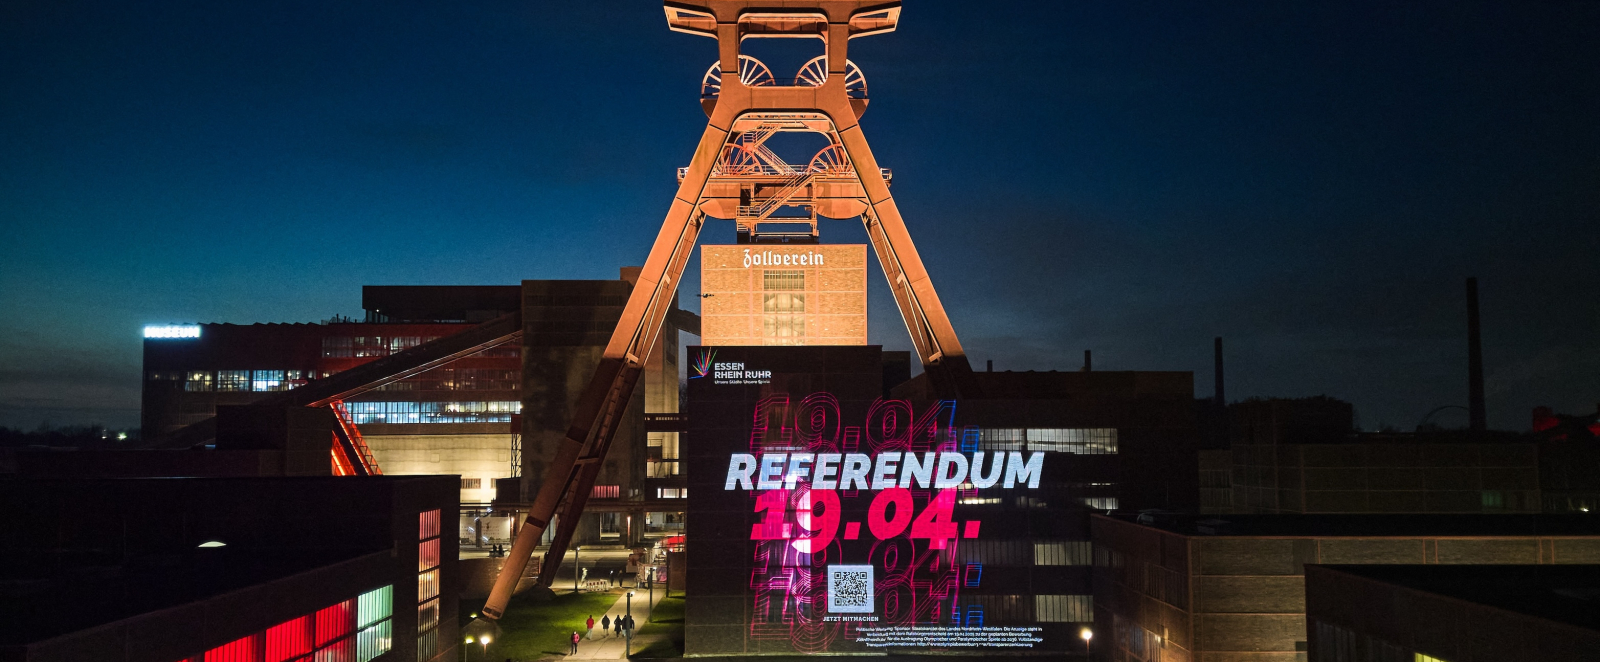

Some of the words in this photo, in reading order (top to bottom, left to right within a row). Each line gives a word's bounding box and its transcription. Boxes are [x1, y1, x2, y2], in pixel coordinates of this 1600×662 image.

[743, 248, 824, 268] Zollverein
[144, 326, 200, 338] MUSEUM
[714, 362, 745, 371] ESSEN
[714, 371, 743, 379] RHEIN
[745, 371, 772, 379] RUHR
[724, 452, 1045, 490] REFERENDUM
[750, 486, 981, 554] 19.04.
